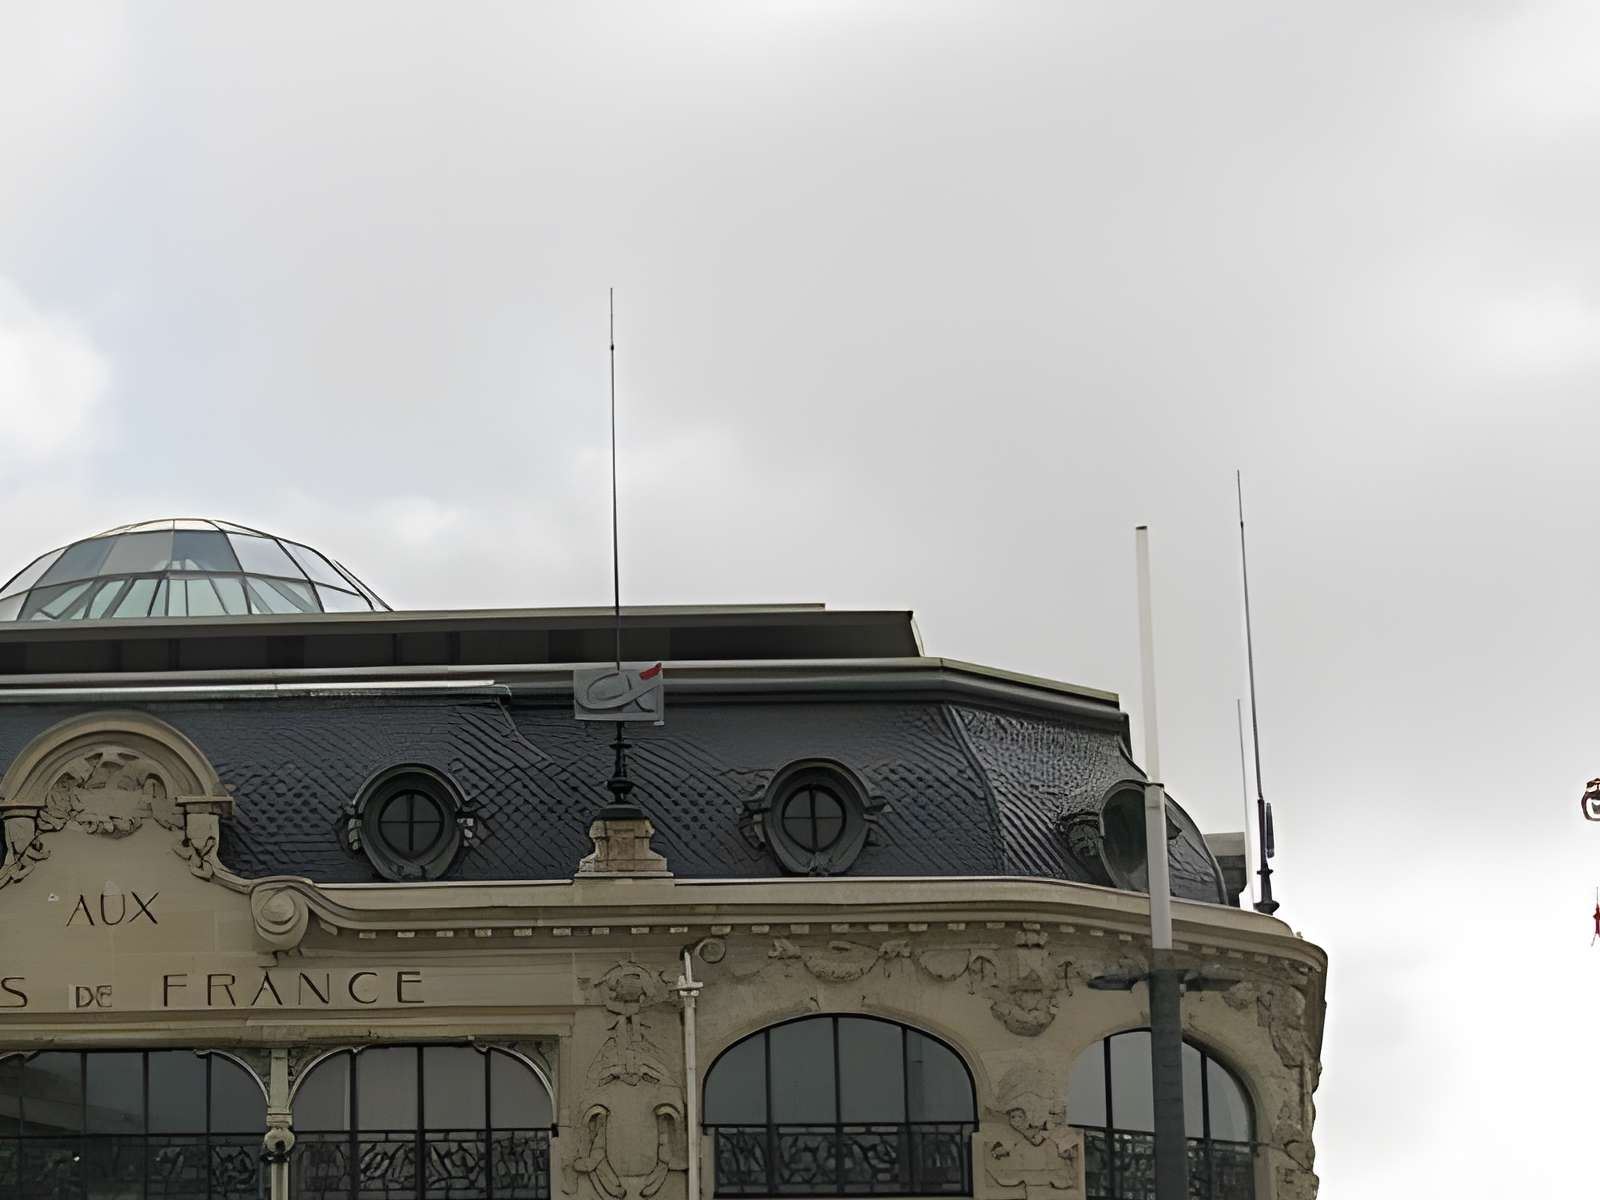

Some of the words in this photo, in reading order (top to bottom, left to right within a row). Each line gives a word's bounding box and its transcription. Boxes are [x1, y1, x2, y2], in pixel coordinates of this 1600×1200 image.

[65, 891, 159, 927] AUX
[74, 984, 113, 1008] DE
[162, 970, 425, 1007] FRANCE
